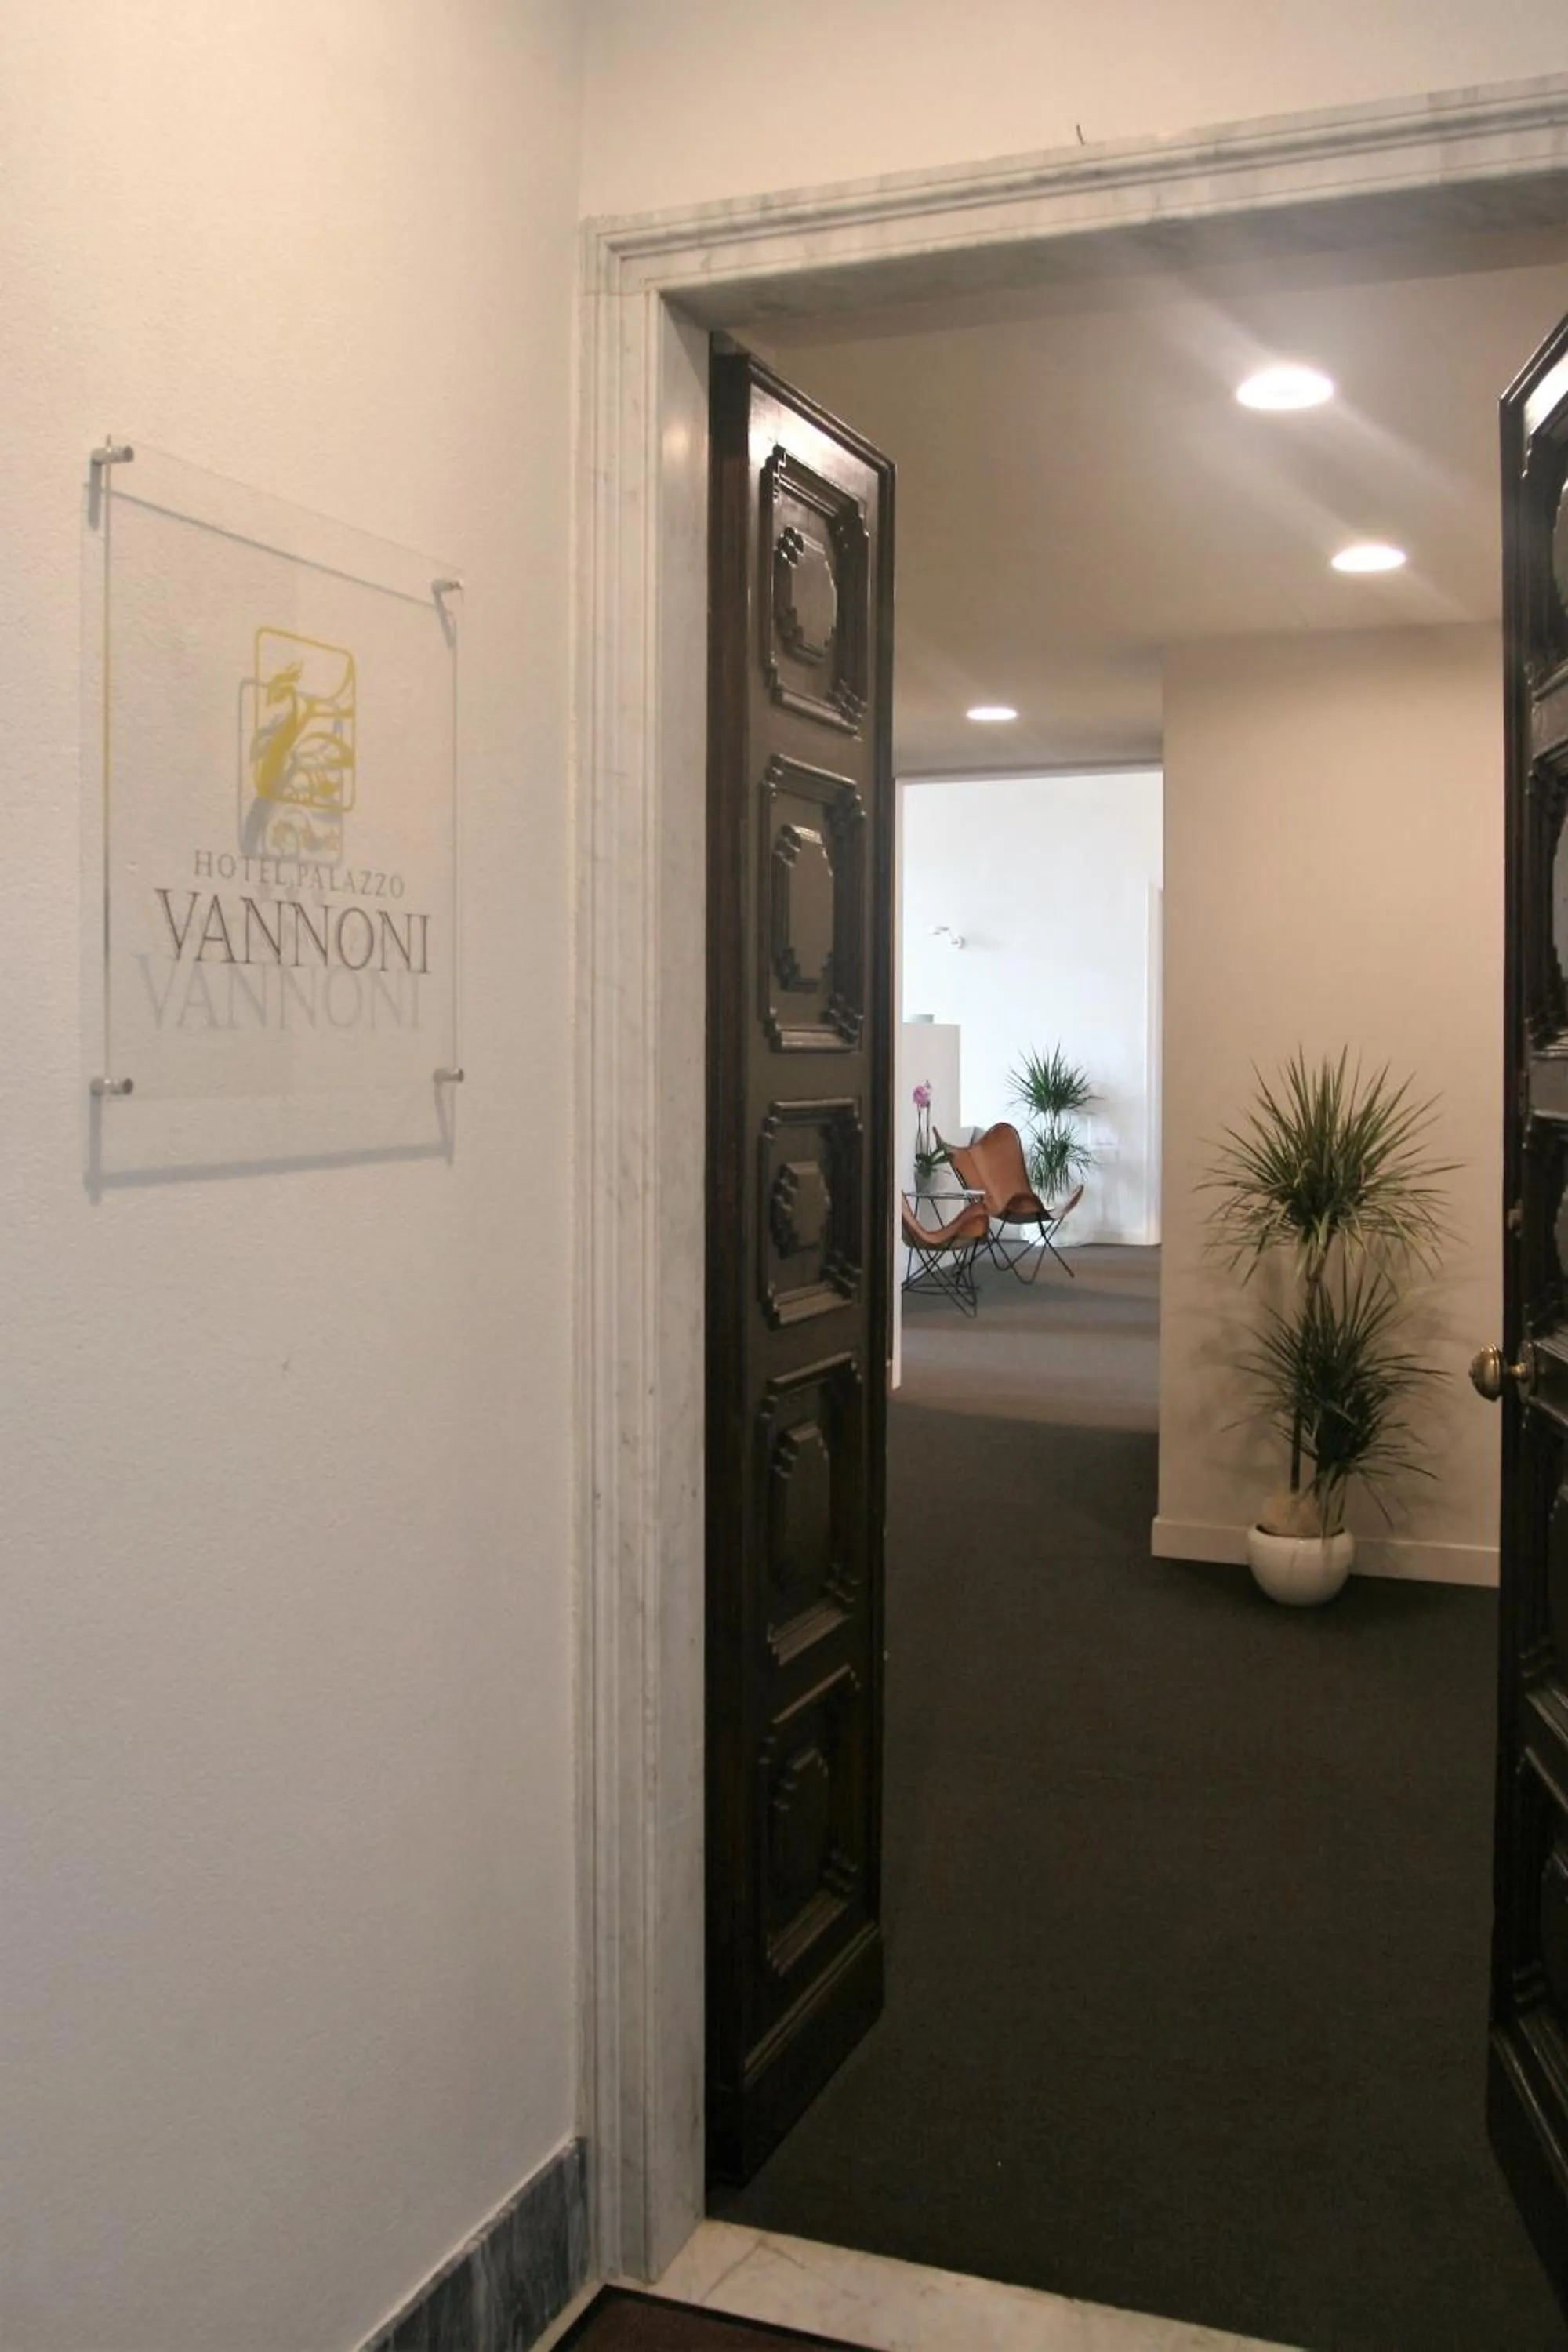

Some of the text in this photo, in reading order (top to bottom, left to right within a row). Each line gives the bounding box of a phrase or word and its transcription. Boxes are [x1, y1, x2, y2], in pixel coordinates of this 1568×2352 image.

[194, 849, 405, 899] HOTEL PALAZZO
[155, 887, 431, 974] VANNONI
